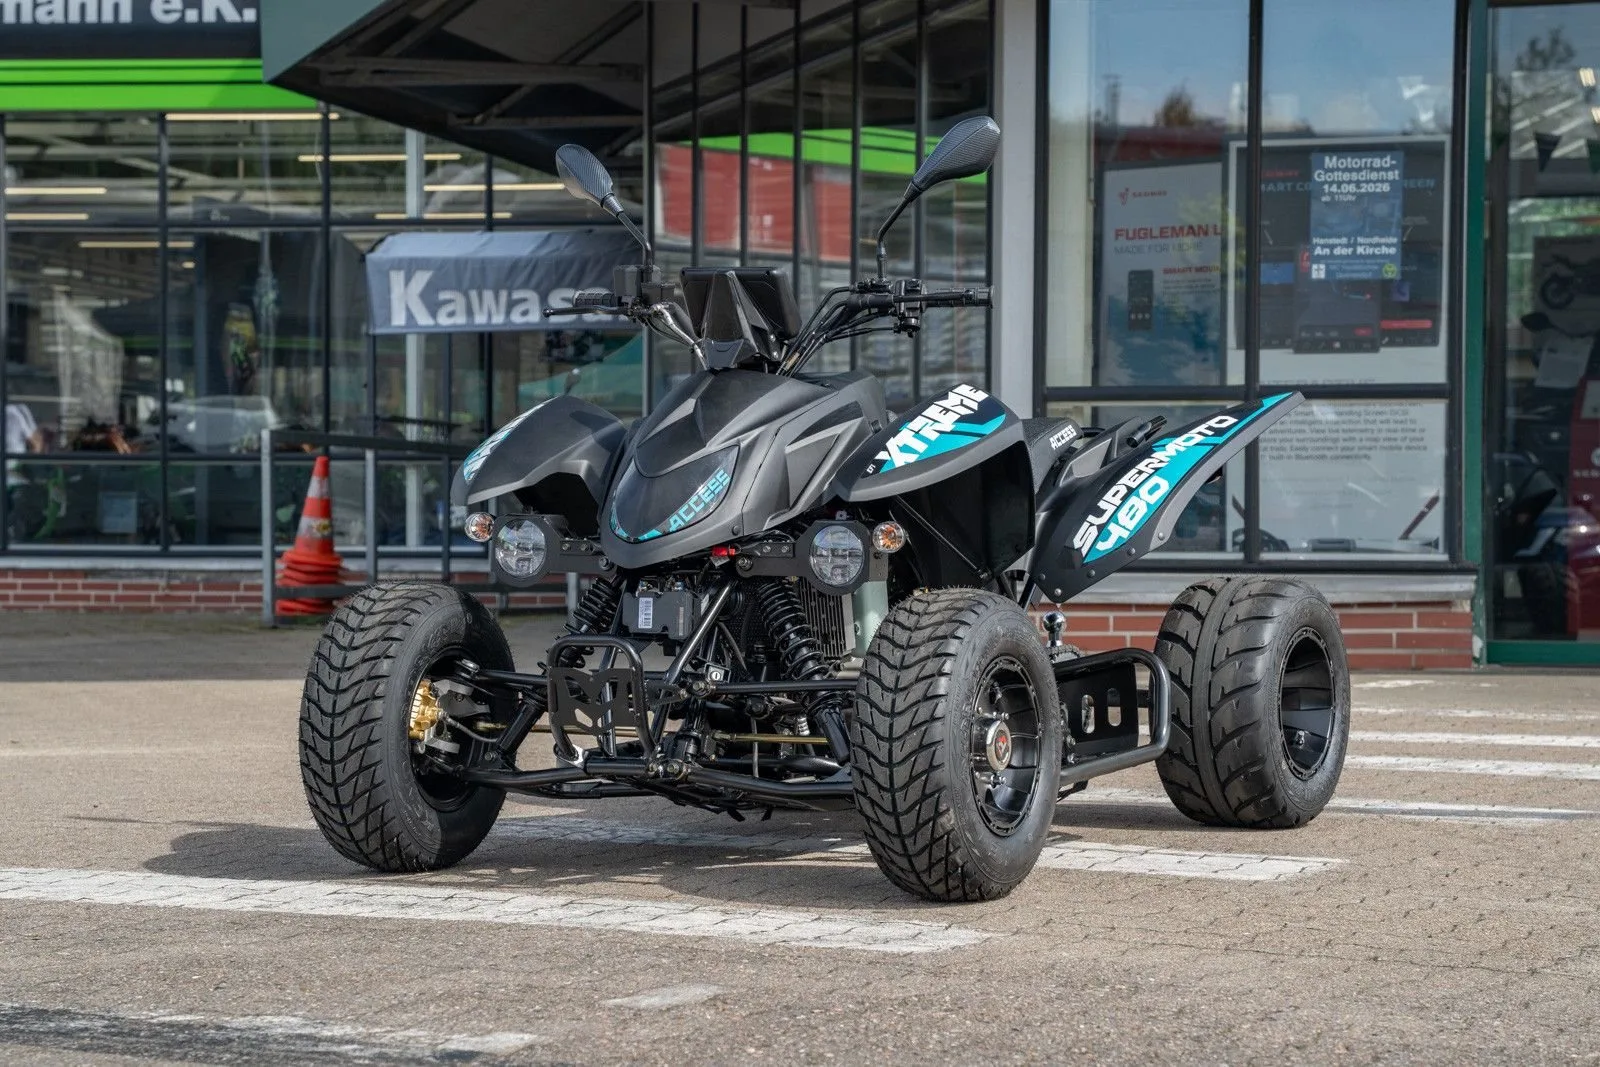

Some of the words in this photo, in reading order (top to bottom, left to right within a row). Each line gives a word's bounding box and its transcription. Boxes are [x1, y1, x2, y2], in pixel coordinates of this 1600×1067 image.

[151, 0, 257, 24] e.K.
[1324, 155, 1397, 169] Motorrad-
[1314, 169, 1400, 182] Gottesdienst
[1114, 223, 1209, 241] FUGLEMAN
[1314, 246, 1330, 256] An
[1333, 245, 1353, 255] der
[1356, 245, 1397, 255] Kirche
[389, 268, 630, 328] Kawas
[874, 383, 989, 468] XTREME
[1048, 424, 1077, 450] ACCESS
[1073, 415, 1238, 557] SUPERMOTO
[669, 469, 731, 532] ACCESS
[1095, 475, 1170, 551] 480
